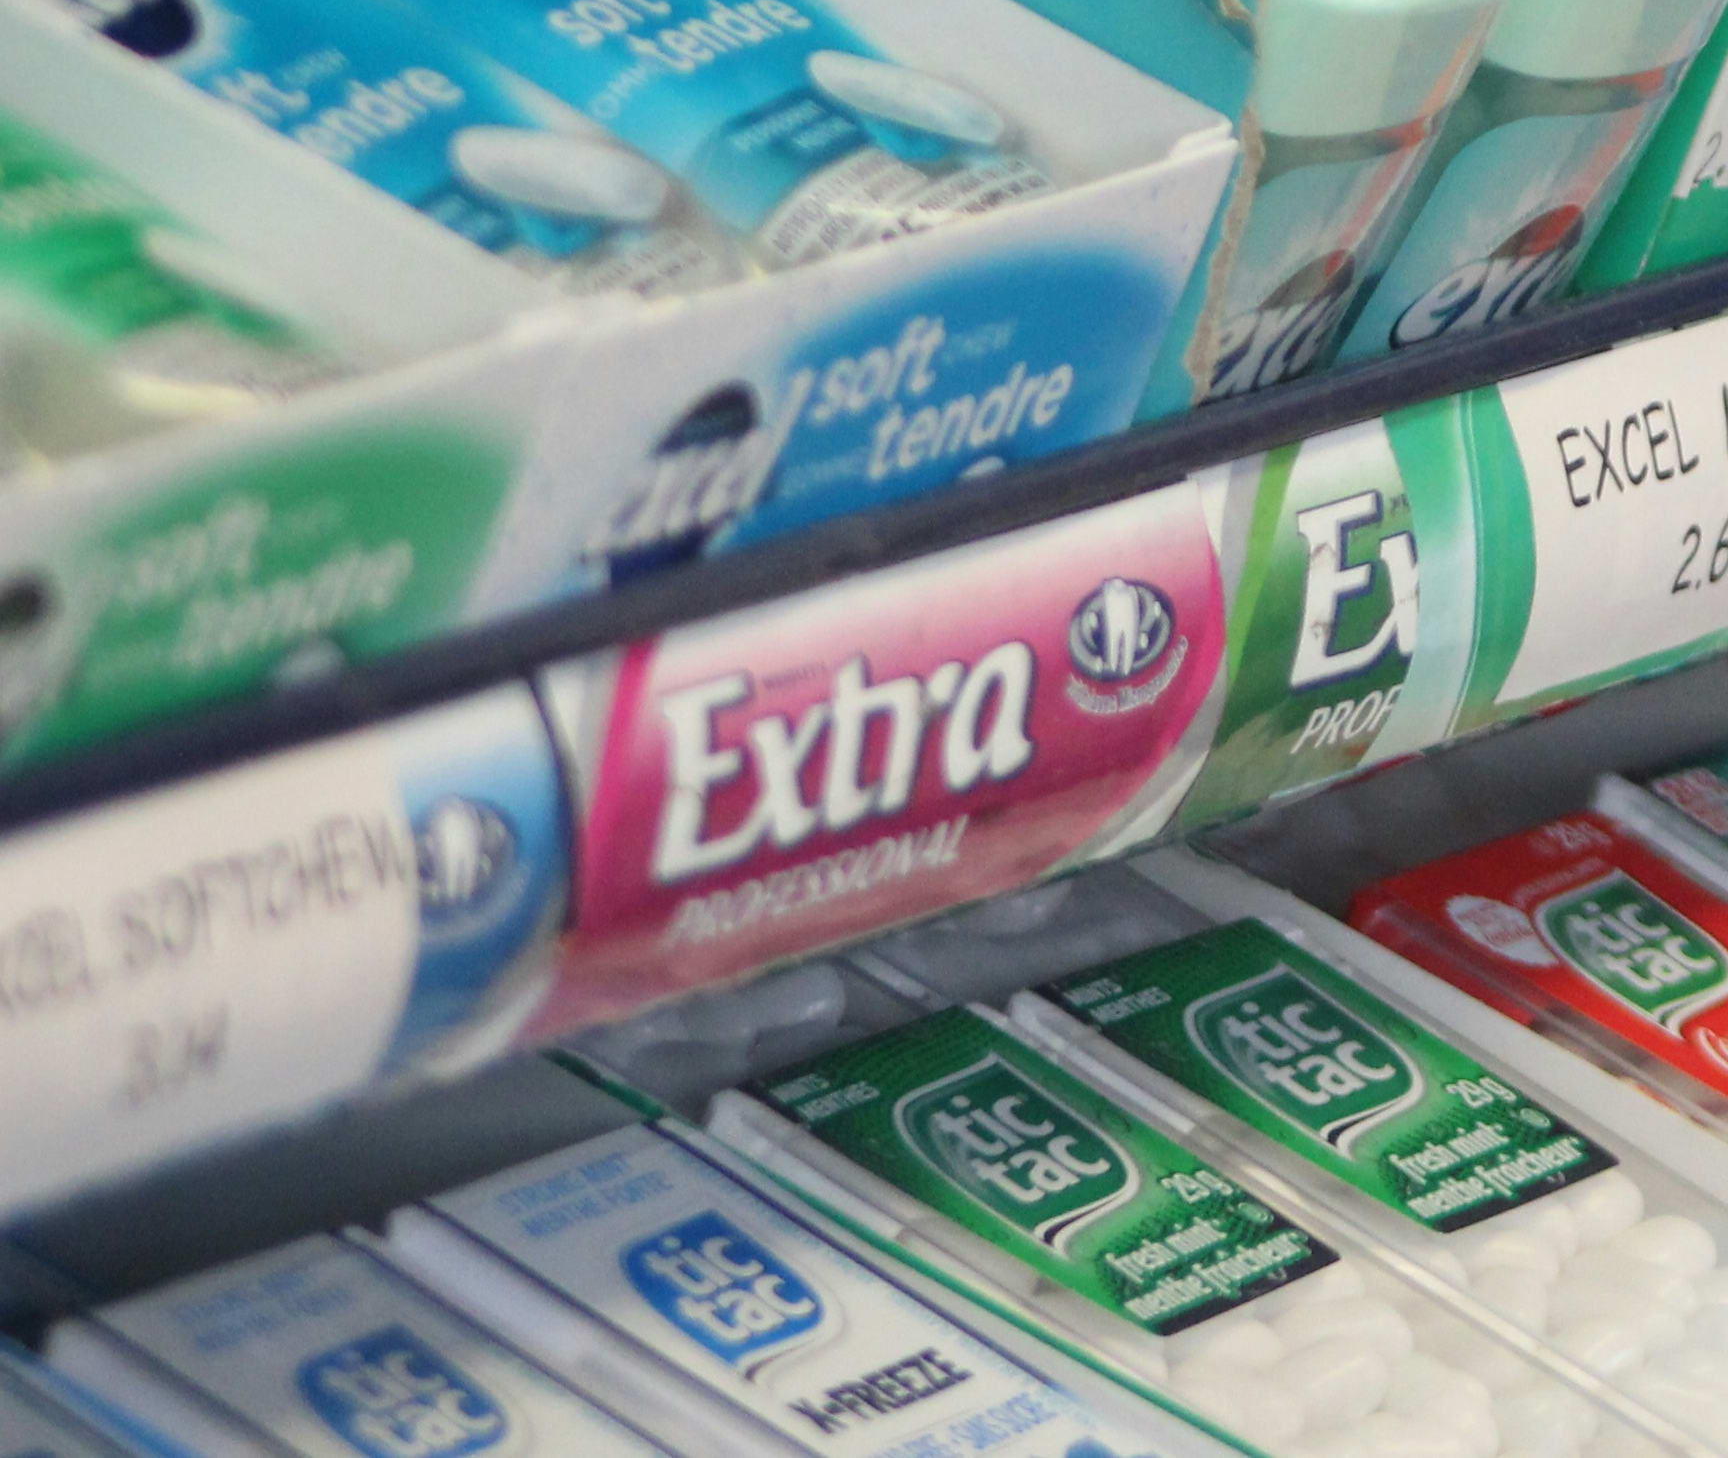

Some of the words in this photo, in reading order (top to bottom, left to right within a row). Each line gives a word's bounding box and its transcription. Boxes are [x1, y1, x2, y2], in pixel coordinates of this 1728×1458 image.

[810, 316, 946, 423] soft
[866, 362, 1076, 482] tendre
[1556, 400, 1700, 509] EXCEL
[652, 639, 1036, 886] Extra
[1567, 899, 1665, 954] tic
[1602, 933, 1718, 993] tac
[1219, 1000, 1343, 1061] tic
[1257, 1035, 1398, 1107] tac
[930, 1093, 1058, 1160] tic
[971, 1137, 1111, 1204] tac
[645, 1234, 766, 1297] tic
[675, 1273, 816, 1344] tac
[788, 1347, 976, 1435] X-FREEZE
